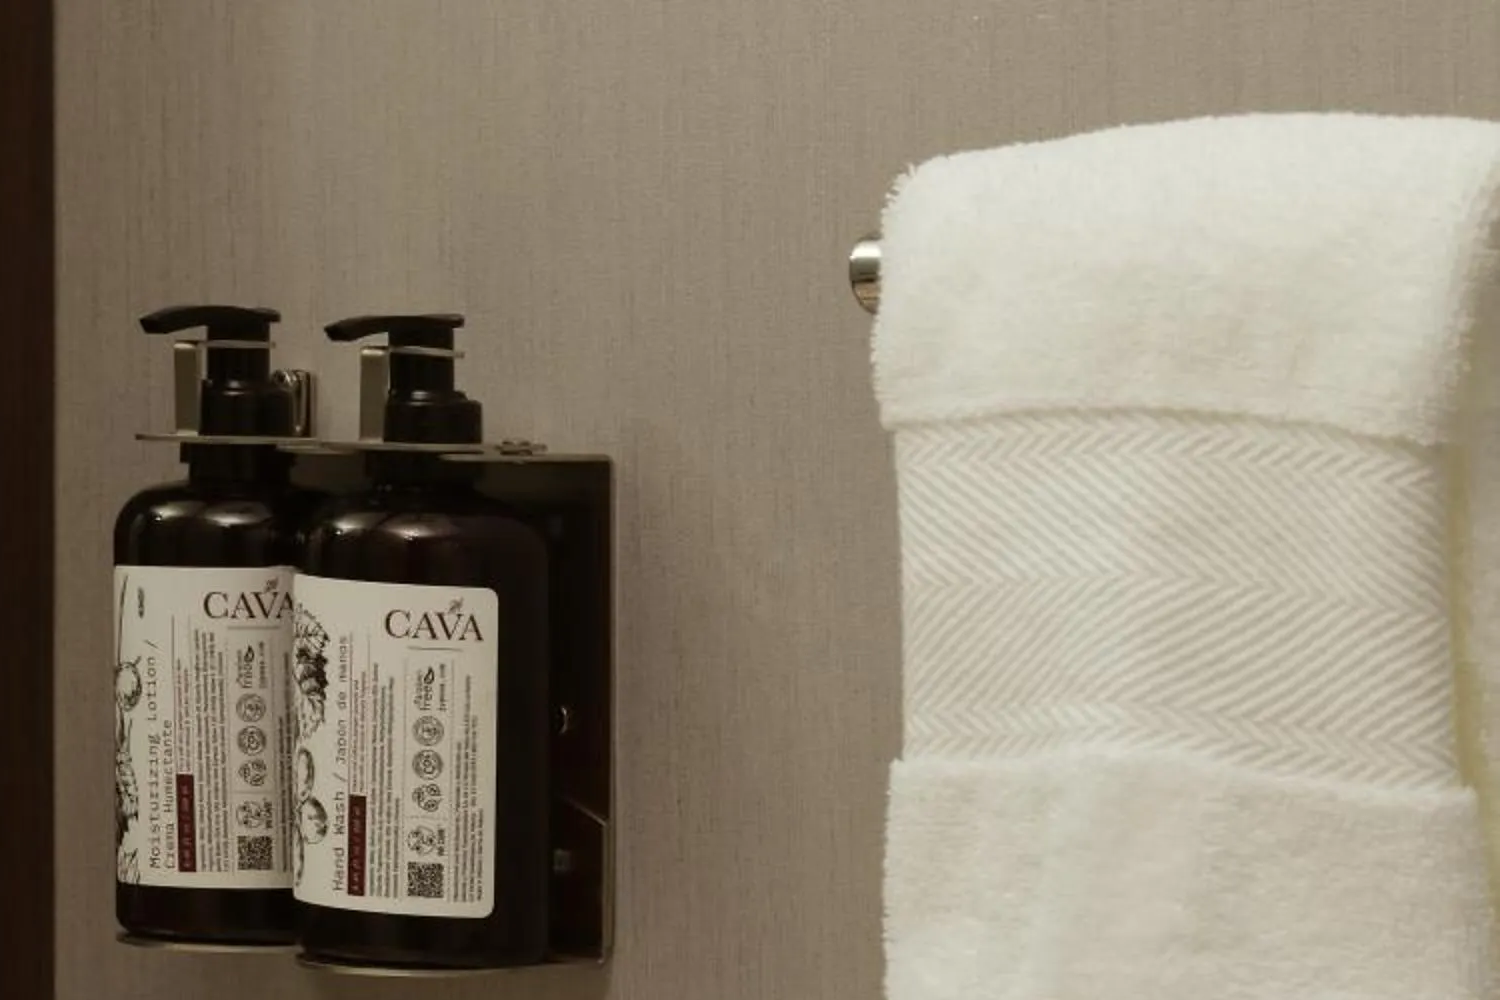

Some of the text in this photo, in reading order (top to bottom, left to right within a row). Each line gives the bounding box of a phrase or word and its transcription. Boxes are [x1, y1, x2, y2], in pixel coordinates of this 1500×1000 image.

[203, 591, 293, 619] CAVA
[385, 608, 484, 642] CAVA
[147, 656, 157, 721] Lotion
[335, 692, 346, 709] de
[147, 734, 161, 869] Moisturizing
[332, 791, 345, 835] Wash
[332, 847, 345, 891] Hand
